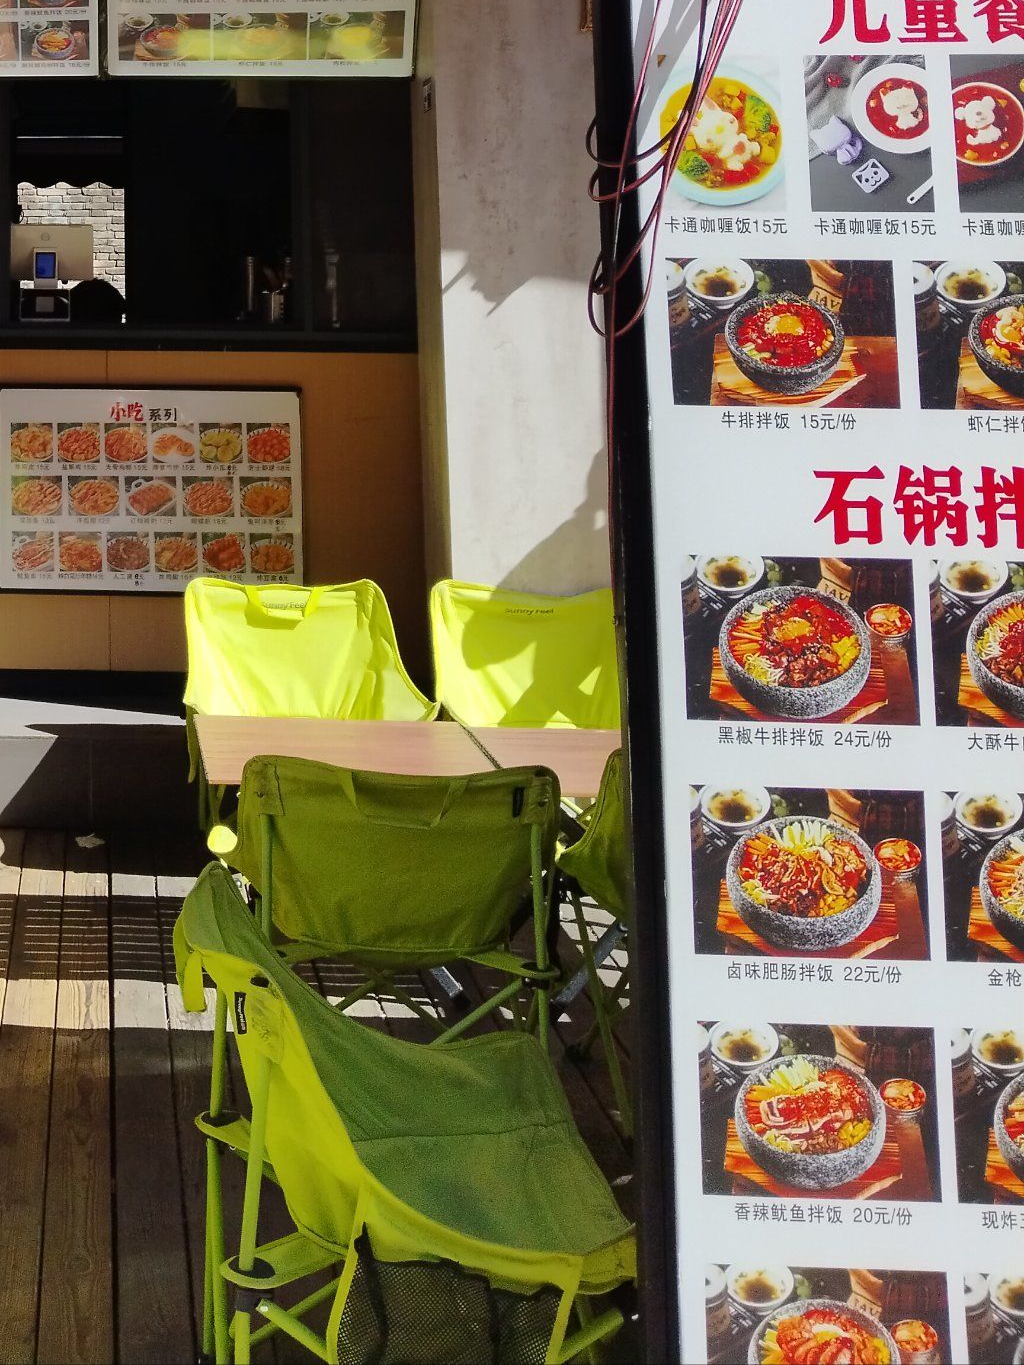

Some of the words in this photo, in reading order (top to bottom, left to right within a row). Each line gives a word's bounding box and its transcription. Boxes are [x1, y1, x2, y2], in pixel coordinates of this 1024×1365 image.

[664, 216, 788, 236] 卡通咖喱饭15元
[814, 218, 937, 237] 卡通咖喱饭15元
[720, 411, 790, 431] 牛排拌饭
[800, 412, 857, 432] 15元/份
[967, 414, 1024, 434] 虾仁拌
[717, 725, 824, 748] 黑椒牛排拌饭
[834, 731, 892, 749] 24元/份
[967, 732, 1024, 752] 大酥牛
[727, 960, 835, 983] 卤味肥肠拌饭
[844, 965, 902, 984] 22元/份
[734, 1202, 843, 1225] 香辣鱿鱼拌饭
[853, 1207, 913, 1226] 20元/份
[981, 1210, 1024, 1230] 现炸
